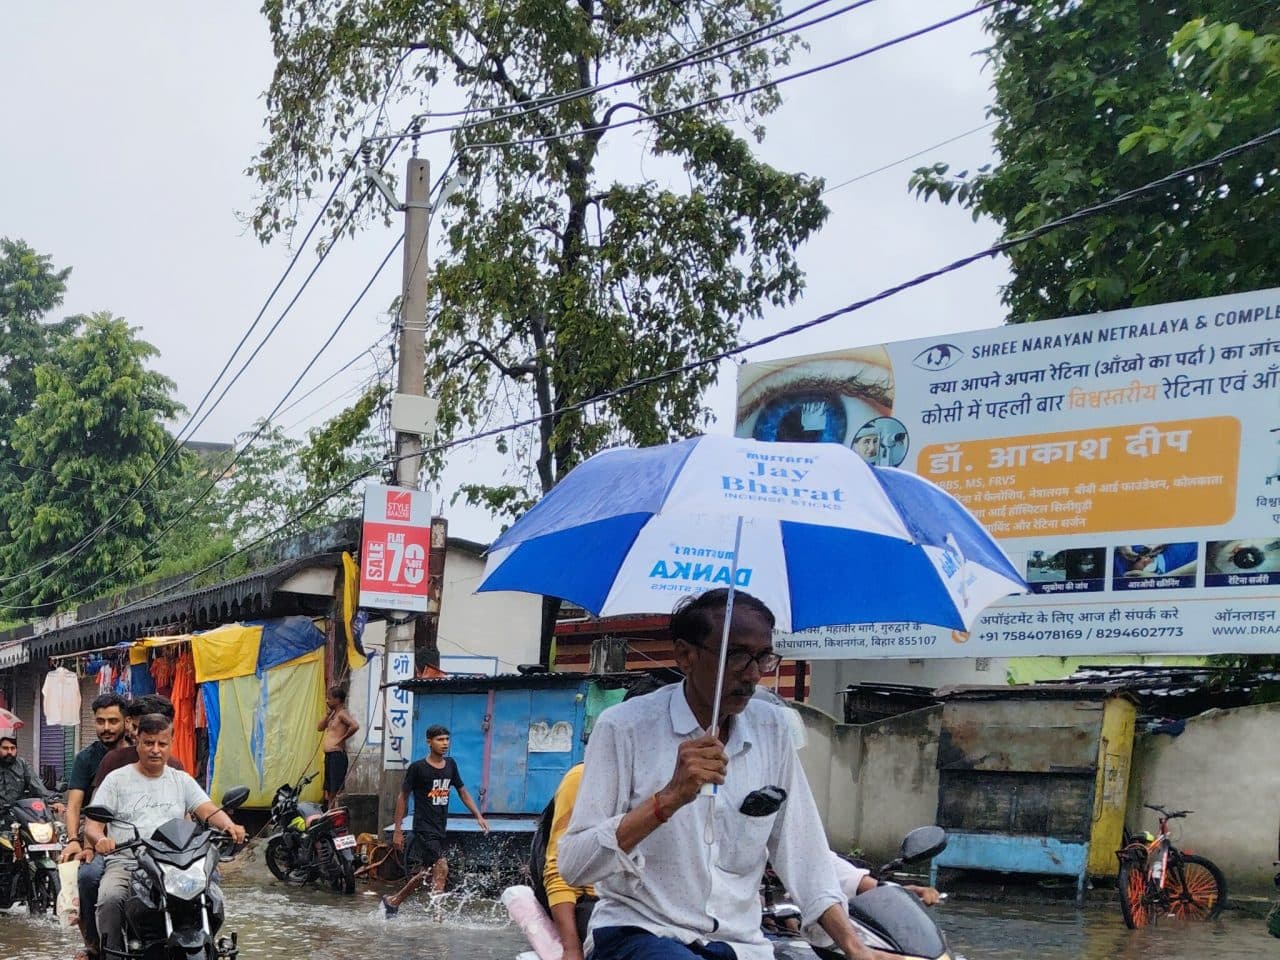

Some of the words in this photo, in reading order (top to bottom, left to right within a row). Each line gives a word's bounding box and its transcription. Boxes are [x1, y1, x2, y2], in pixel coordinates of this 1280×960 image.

[971, 340, 1018, 359] SHREE
[1022, 330, 1093, 352] NARAYAN
[1097, 318, 1189, 343] NETRALAYA
[1194, 315, 1208, 330] &
[929, 380, 956, 395] क्या
[960, 371, 1000, 391] आपने
[1004, 369, 1045, 387] अपना
[1049, 361, 1091, 381] रेटिना
[1148, 354, 1171, 369] का
[1175, 343, 1206, 367] पर्दा
[1220, 345, 1246, 360] का
[921, 400, 963, 425] कोसी
[967, 398, 984, 420] में
[985, 391, 1032, 419] पहली
[1036, 394, 1066, 413] बार
[1162, 374, 1215, 400] रेटिना
[1218, 368, 1249, 393] एवं
[928, 443, 974, 475] डॉ.
[987, 438, 1112, 469] आकाश
[1125, 425, 1193, 458] दीप
[748, 462, 810, 482] Jay
[988, 474, 1017, 486] FRVS
[721, 475, 845, 502] Bharat
[387, 532, 405, 544] FLAT
[368, 543, 384, 579] SALE
[1036, 610, 1049, 624] के
[1051, 610, 1075, 625] लिए
[1077, 611, 1106, 623] आज
[1108, 608, 1123, 623] ही
[1124, 606, 1157, 621] संपर्क
[1214, 608, 1277, 622] ऑनलाइन
[870, 636, 896, 648] बिहार
[898, 635, 937, 647] 855107
[979, 631, 999, 641] +91
[1002, 629, 1083, 641] 7584078169
[1095, 626, 1184, 639] 8294602773
[432, 778, 451, 790] PLAY
